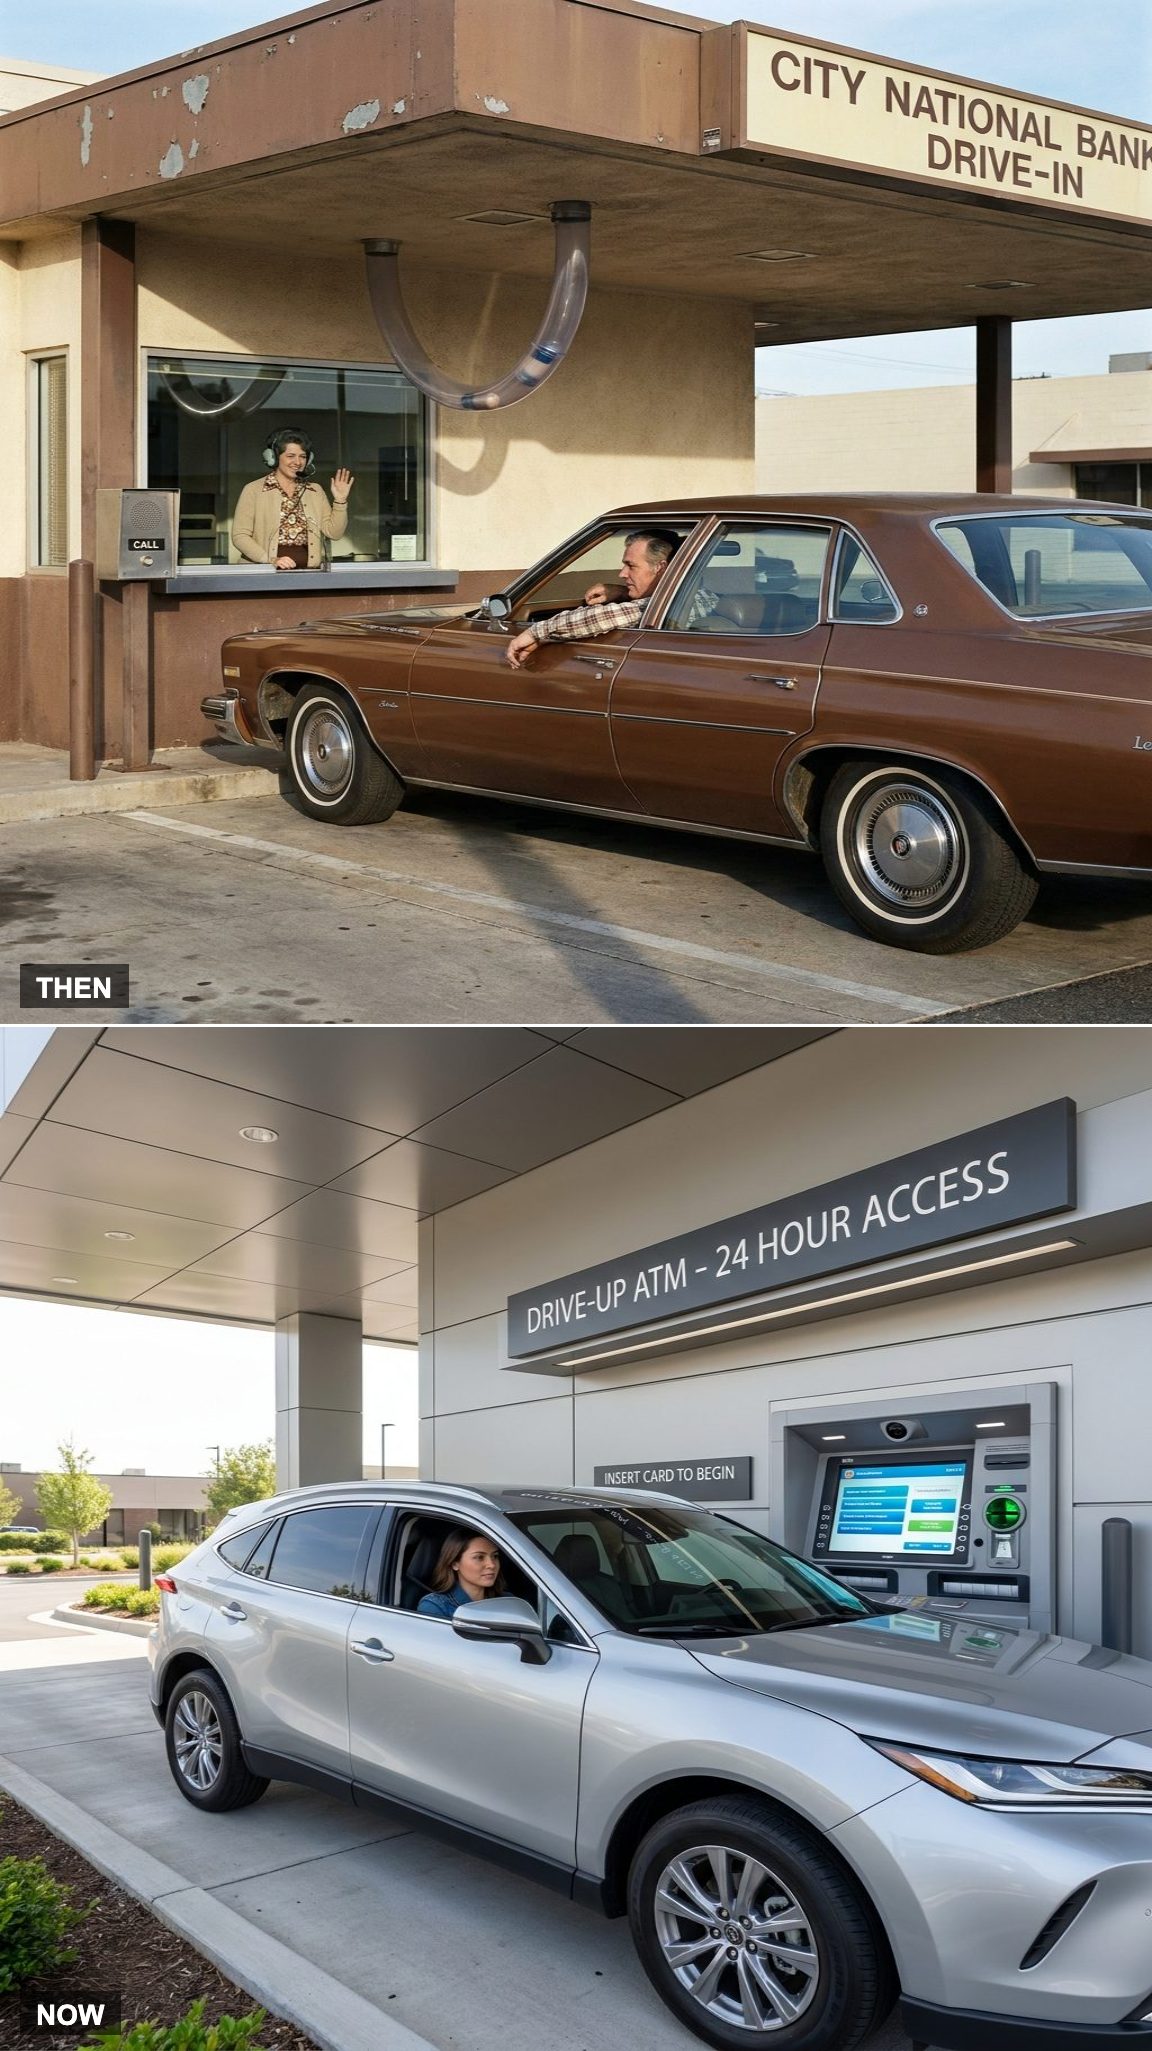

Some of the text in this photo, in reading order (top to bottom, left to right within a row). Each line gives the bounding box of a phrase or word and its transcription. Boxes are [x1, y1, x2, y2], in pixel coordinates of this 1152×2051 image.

[771, 50, 1152, 171] CITY NATIONAL BANK
[928, 133, 1084, 199] DRIVE-IN
[133, 540, 160, 549] CALL
[527, 1278, 627, 1334] DRIVE-UP
[633, 1258, 687, 1303] ATM
[716, 1238, 749, 1278] 24
[758, 1205, 851, 1265] HOUR
[862, 1151, 1011, 1235] ACCESS
[604, 1465, 735, 1485] INSERT CARD TO BEGIN
